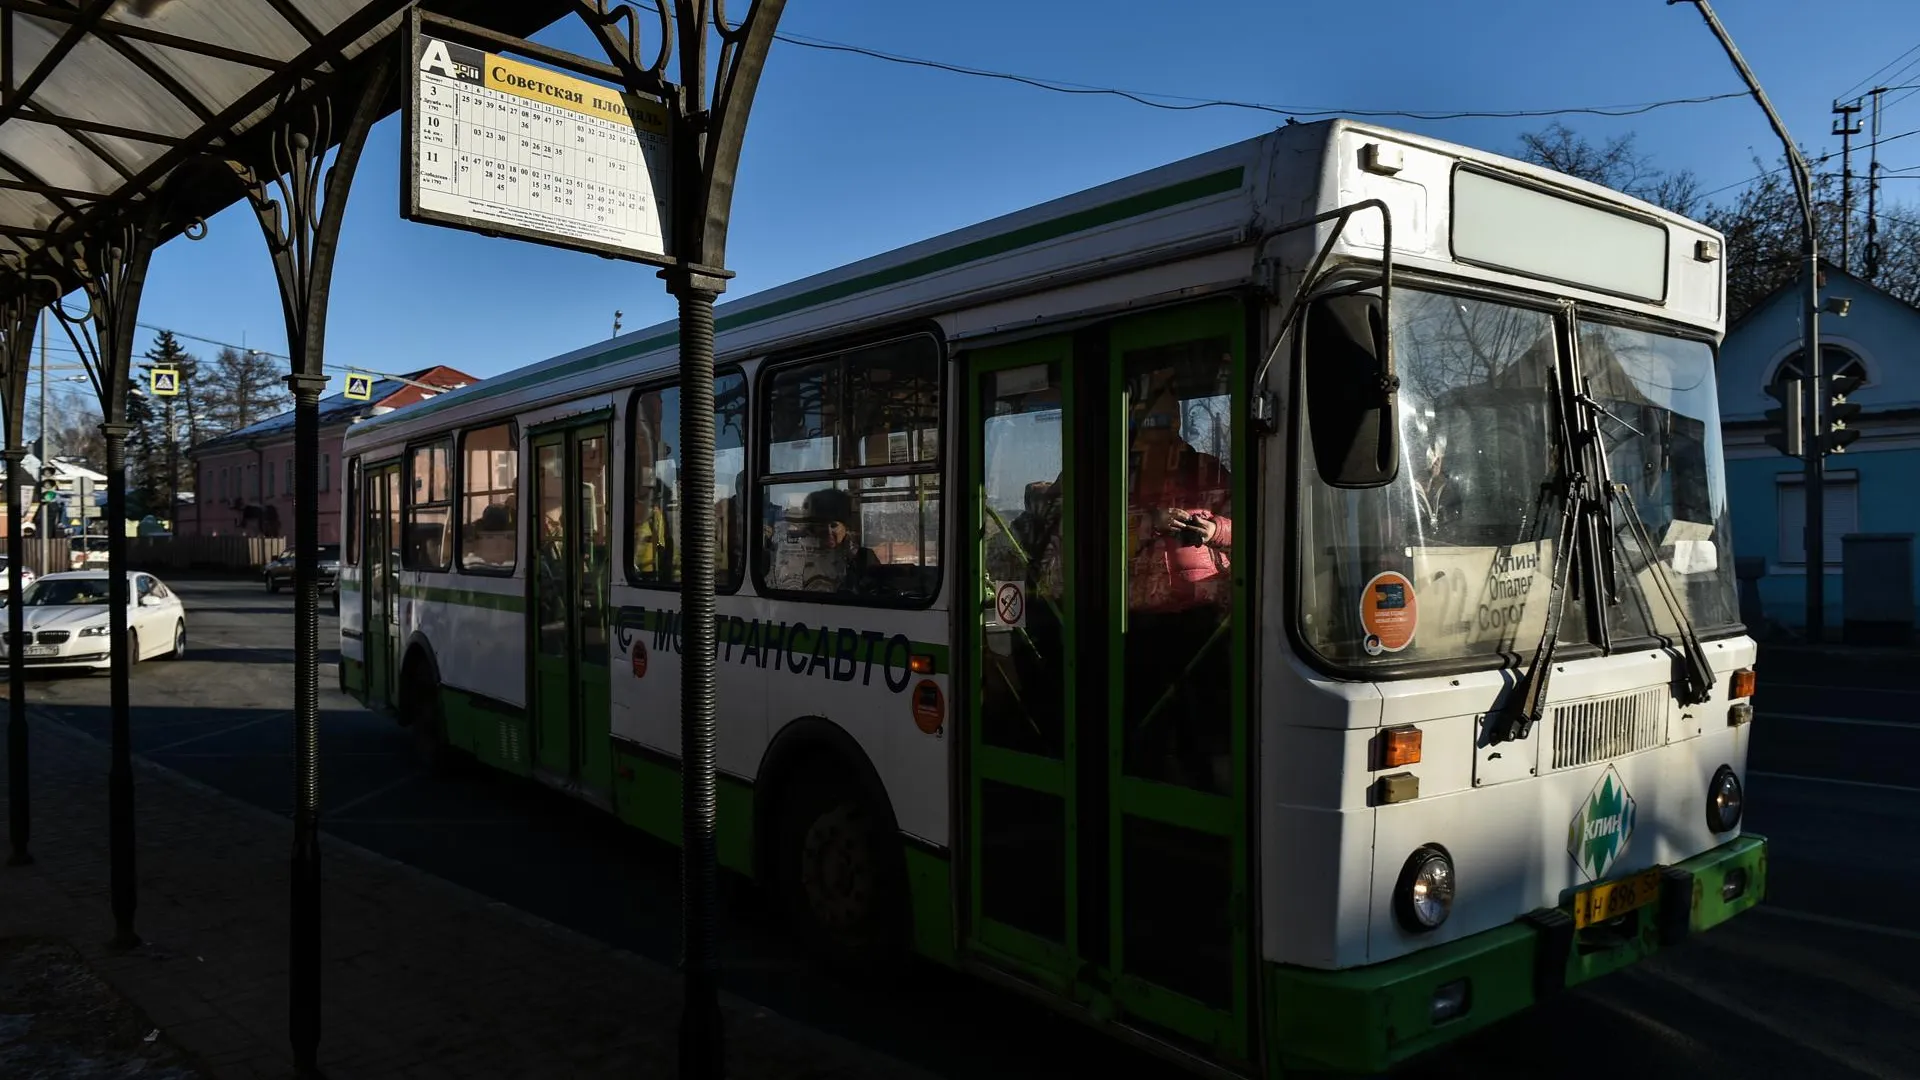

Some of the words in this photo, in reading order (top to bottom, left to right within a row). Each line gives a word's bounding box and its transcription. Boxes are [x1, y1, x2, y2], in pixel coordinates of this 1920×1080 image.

[430, 87, 436, 95] 3
[491, 66, 584, 105] Советская
[428, 117, 439, 127] 10
[544, 115, 552, 123] 47
[555, 118, 562, 126] 57
[427, 152, 438, 162] 11
[653, 608, 912, 693] МОТРАНСАВТО
[1584, 813, 1622, 841] КЛИН
